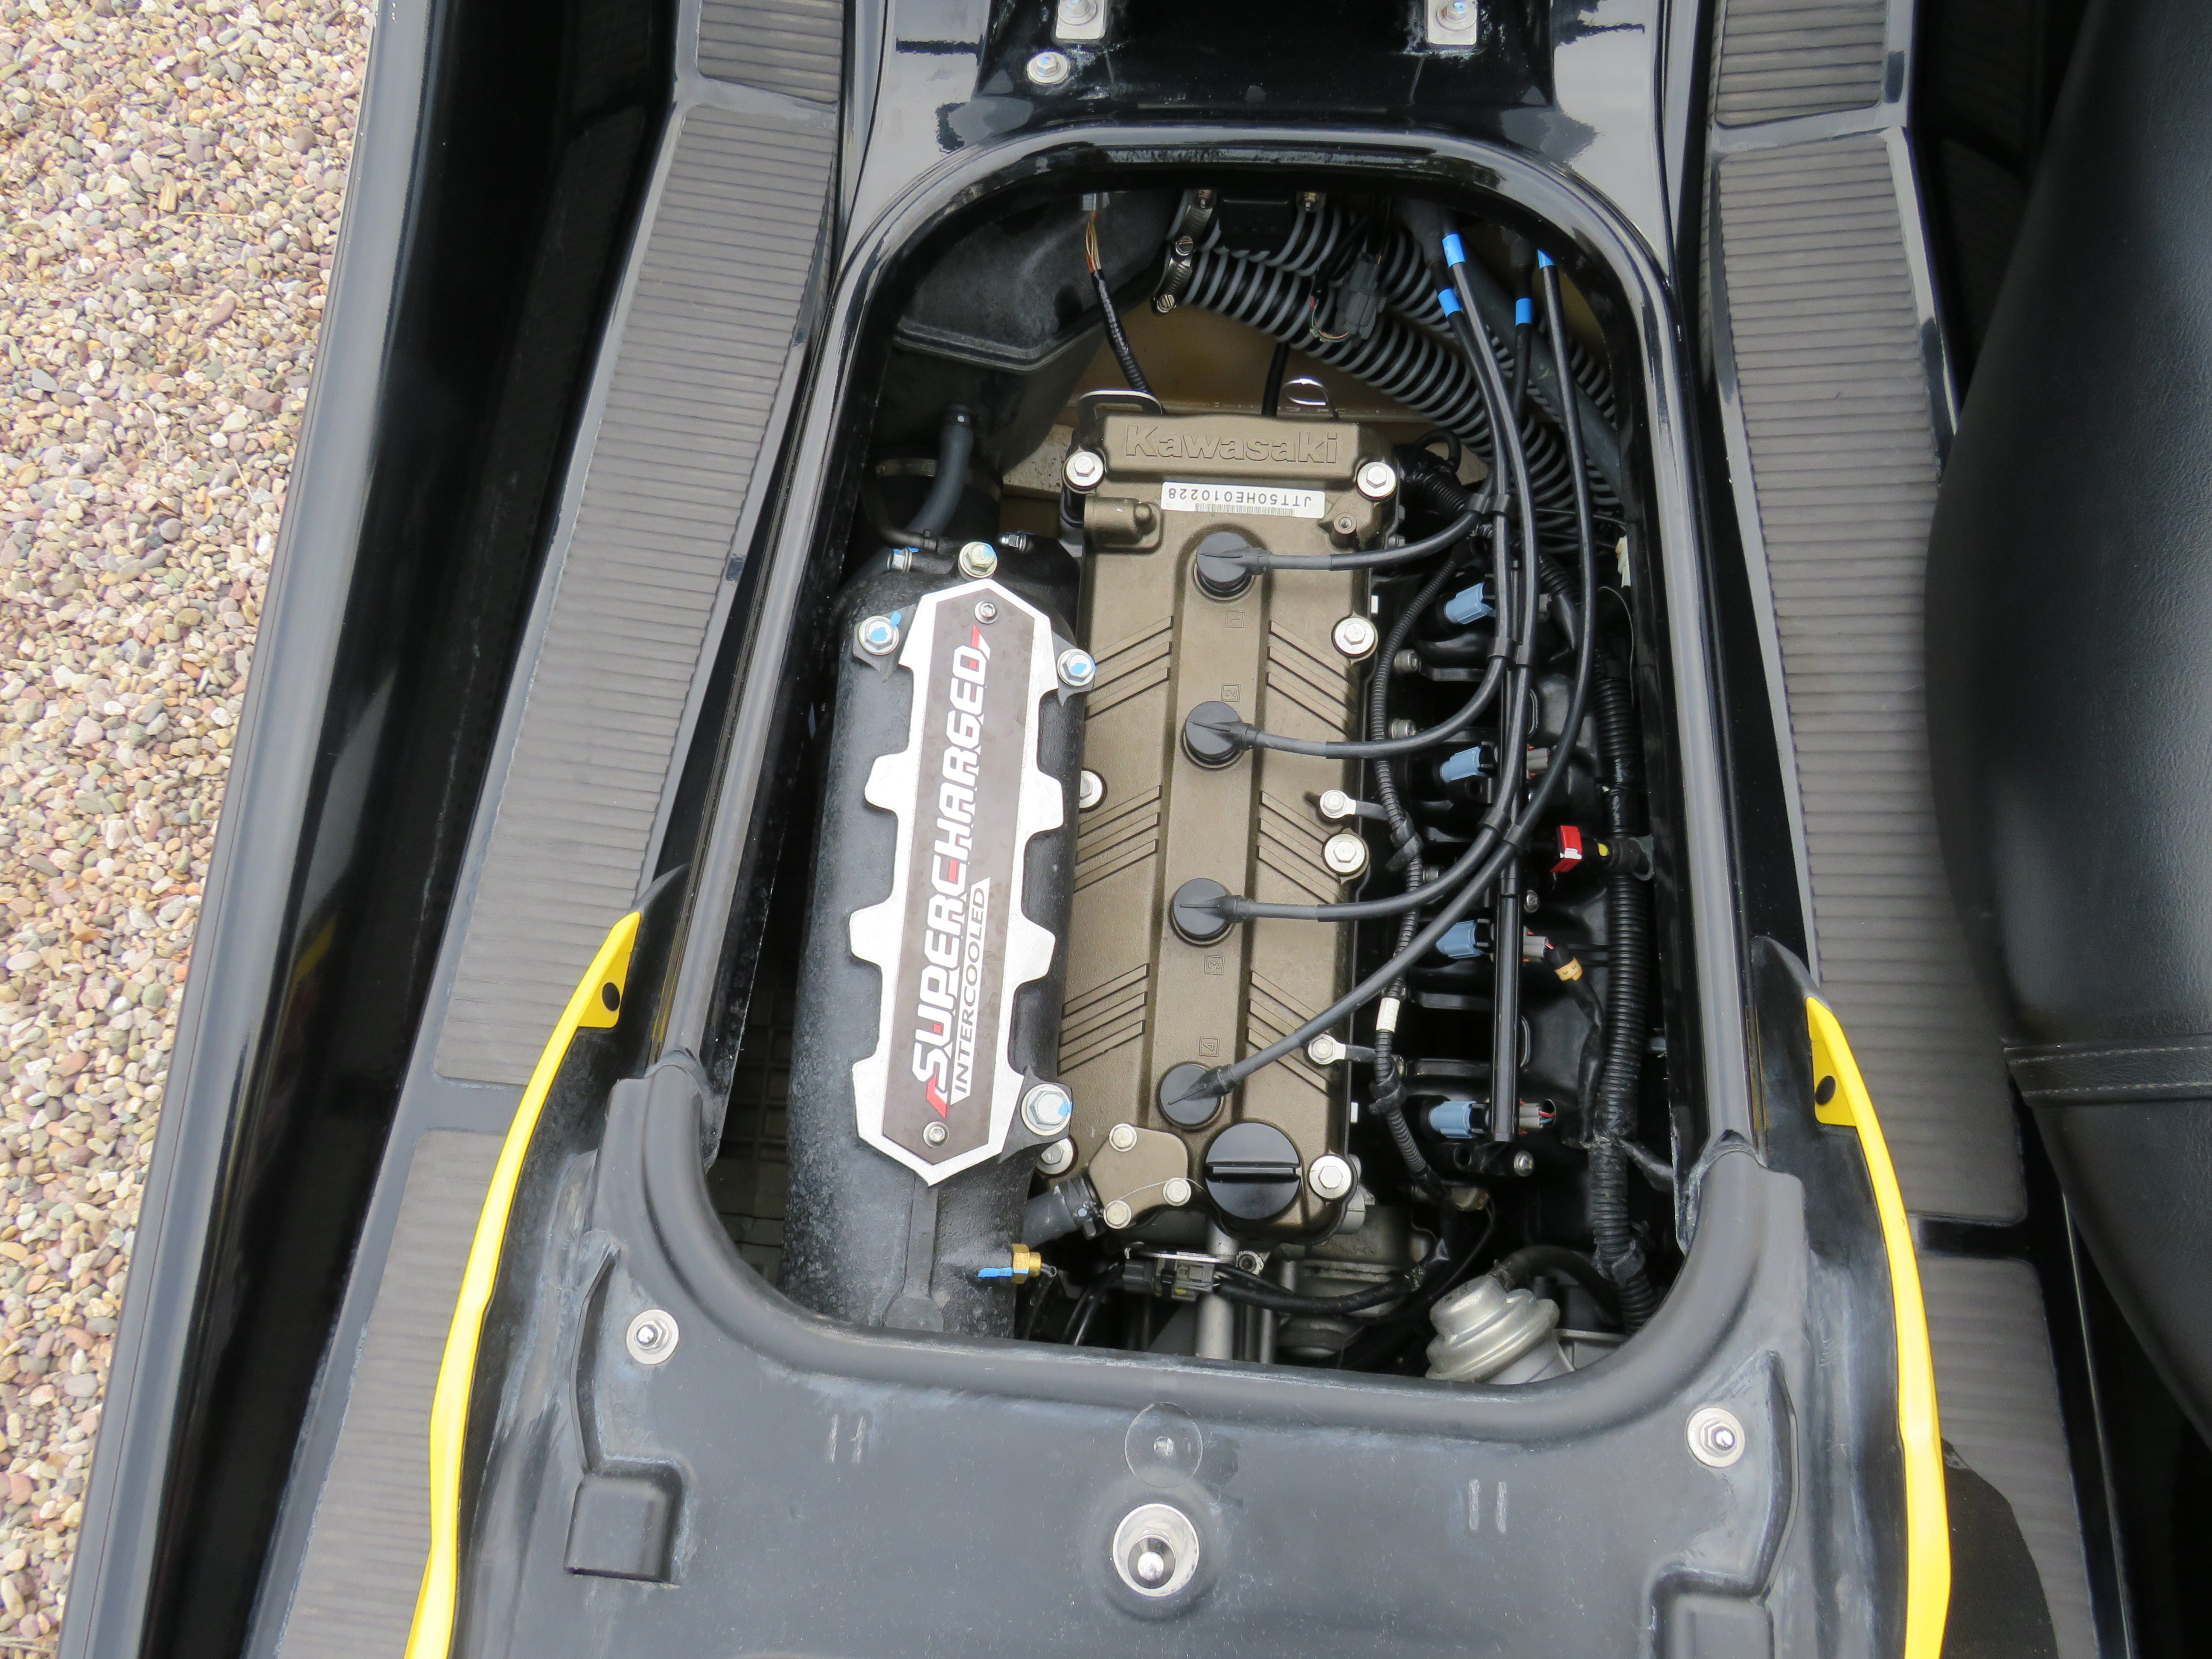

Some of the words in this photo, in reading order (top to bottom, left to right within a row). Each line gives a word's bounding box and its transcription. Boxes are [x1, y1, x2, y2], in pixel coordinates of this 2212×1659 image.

[1126, 425, 1338, 463] Kawasaki
[1168, 488, 1311, 507] JTT50HE010228
[912, 625, 990, 1115] SUPERCHARGED
[1208, 960, 1220, 969] 3
[955, 888, 985, 1093] INTERCOOLED
[1203, 1042, 1215, 1051] 4
